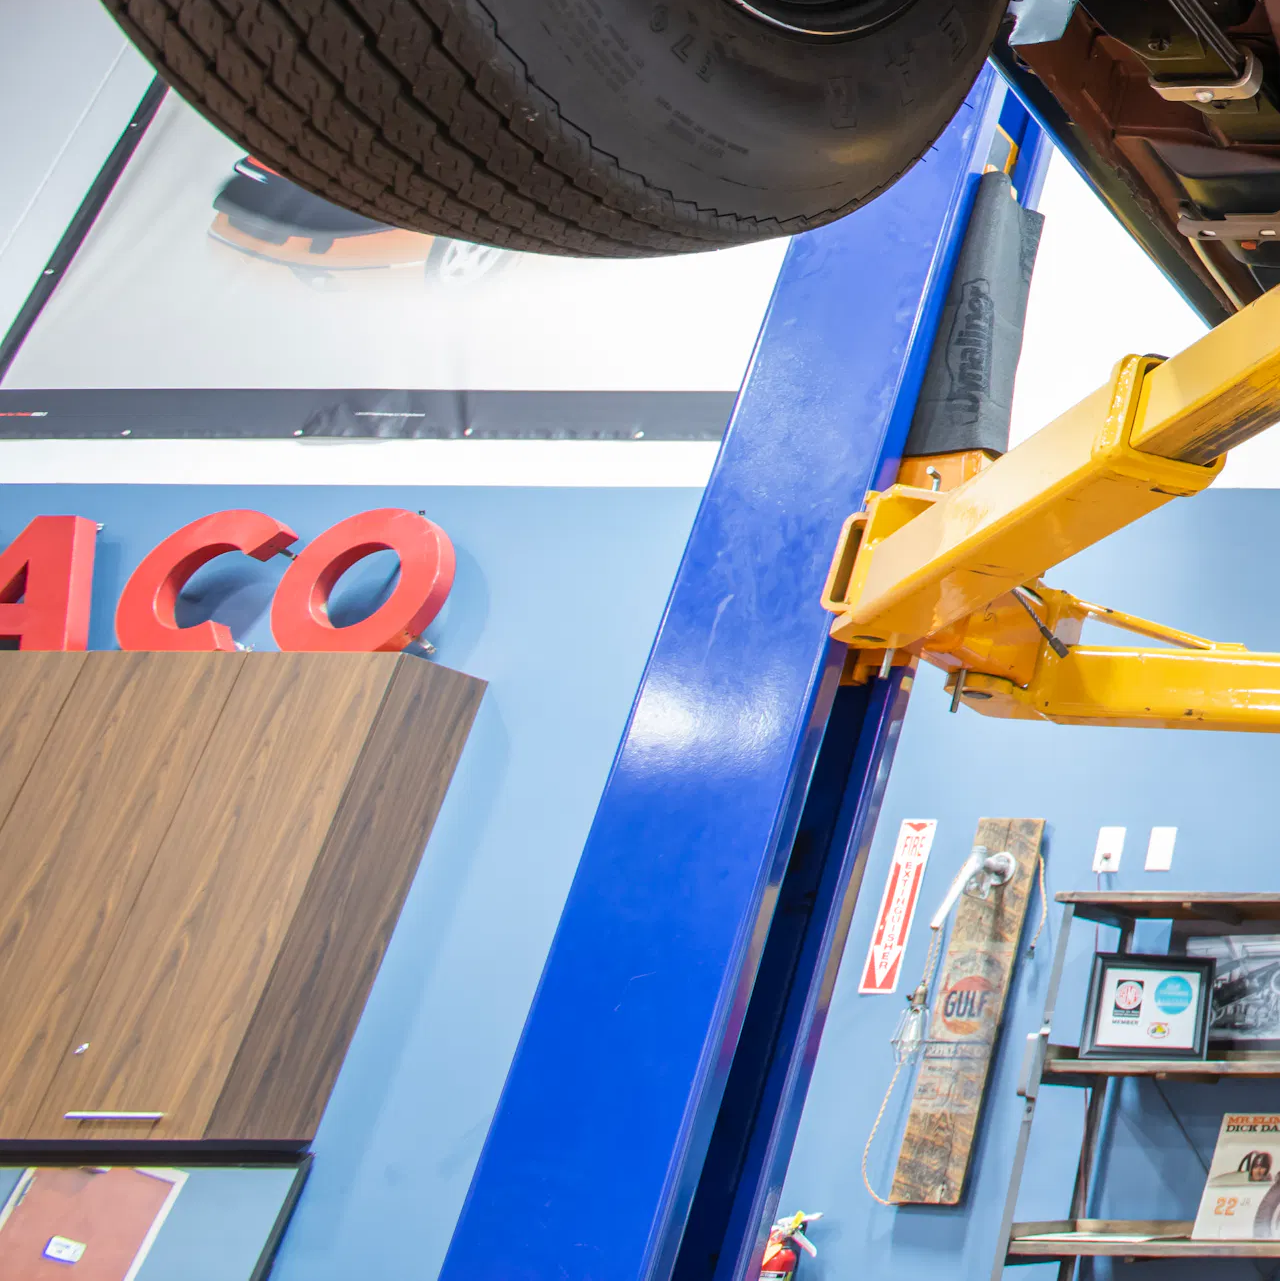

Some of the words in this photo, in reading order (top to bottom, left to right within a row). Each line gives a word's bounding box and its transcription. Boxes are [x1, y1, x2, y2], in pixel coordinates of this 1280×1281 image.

[902, 835, 927, 857] FIRE
[878, 861, 913, 969] EXTINGUISHER
[943, 990, 989, 1018] GULF
[1226, 1124, 1258, 1132] DICK
[1213, 1197, 1239, 1216] 22
